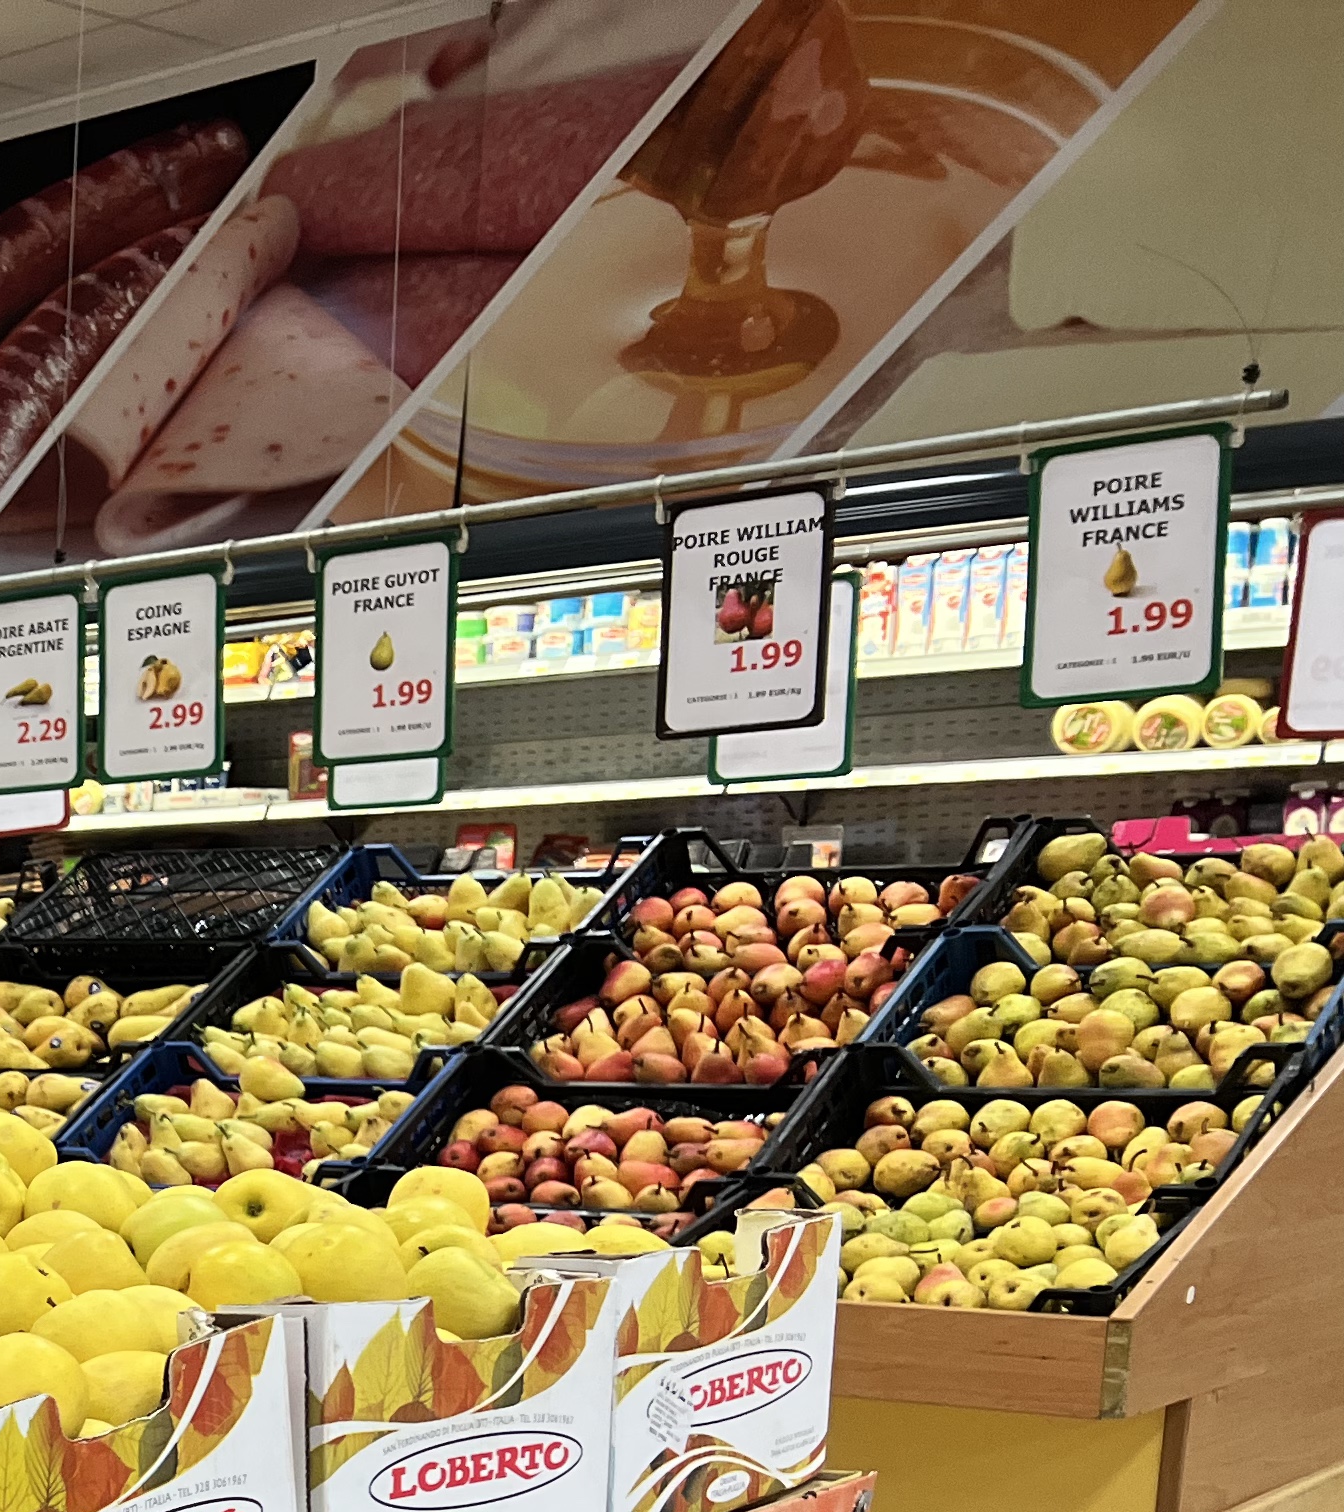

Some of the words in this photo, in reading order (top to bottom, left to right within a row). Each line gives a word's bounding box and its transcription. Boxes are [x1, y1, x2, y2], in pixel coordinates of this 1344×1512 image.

[1093, 472, 1163, 497] POIRE
[1069, 494, 1185, 525] WILLIAMS
[672, 529, 730, 551] POIRE
[1082, 520, 1169, 547] FRANCE
[713, 545, 780, 568] ROUGE
[331, 576, 380, 596] POIRE
[384, 568, 440, 589] GUYOT
[709, 567, 784, 591] FRANCE
[135, 602, 183, 621] COING
[354, 592, 415, 614] FRANCE
[28, 618, 69, 635] ABATE
[127, 620, 191, 642] ESPAGNE
[1106, 599, 1193, 636] 1.99
[729, 639, 803, 674] 1.99
[372, 678, 433, 708] 1.99
[149, 701, 204, 730] 2.99
[17, 717, 68, 744] 2.29
[690, 1358, 802, 1411] OBERTO
[388, 1439, 570, 1500] LOBERTO
[144, 1493, 172, 1511] ITALIA
